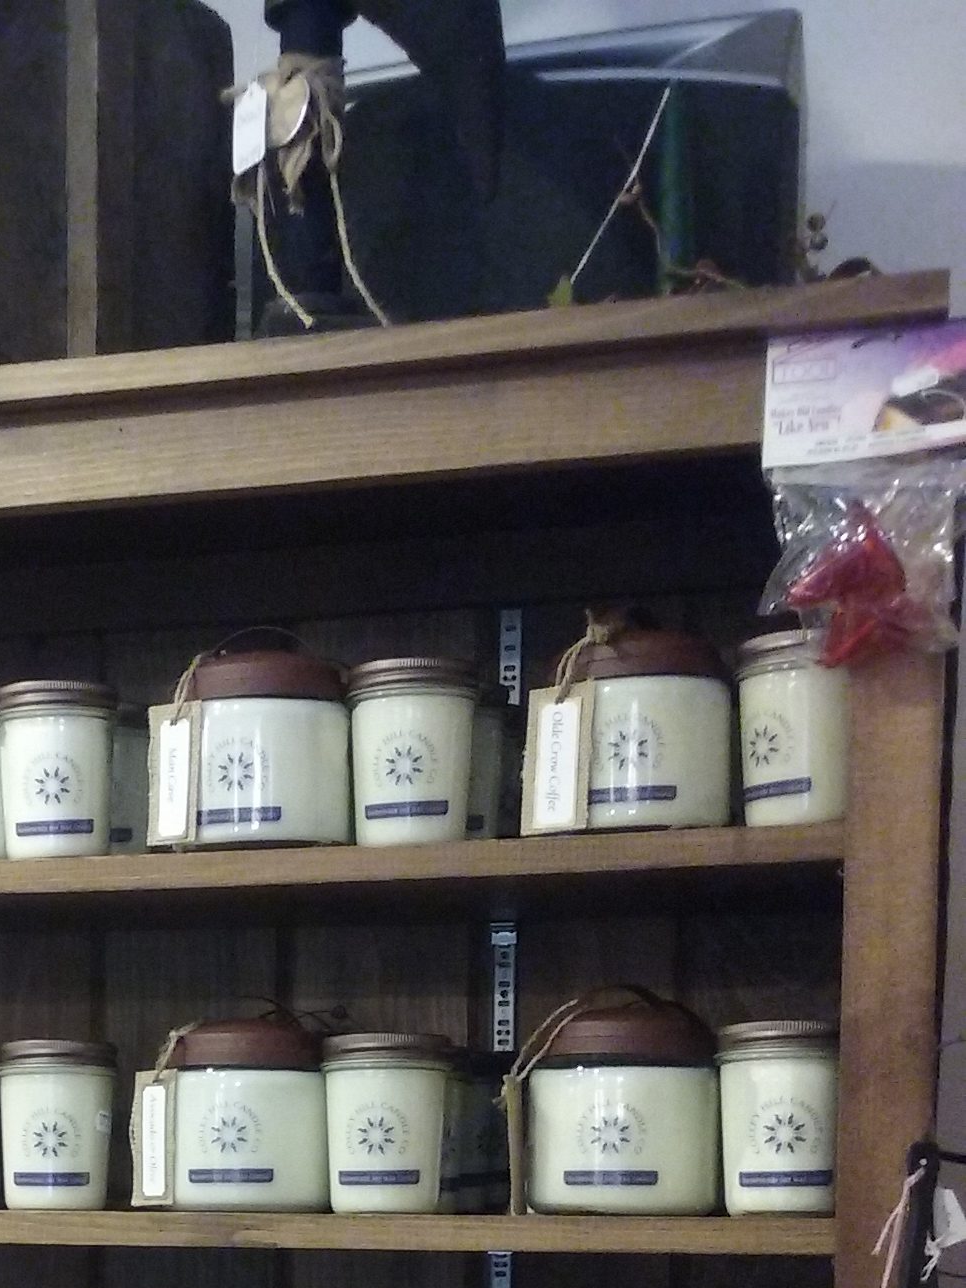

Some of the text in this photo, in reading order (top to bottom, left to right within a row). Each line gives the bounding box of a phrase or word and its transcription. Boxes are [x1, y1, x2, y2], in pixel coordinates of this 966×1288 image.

[545, 711, 564, 812] Olde Crow Coffee
